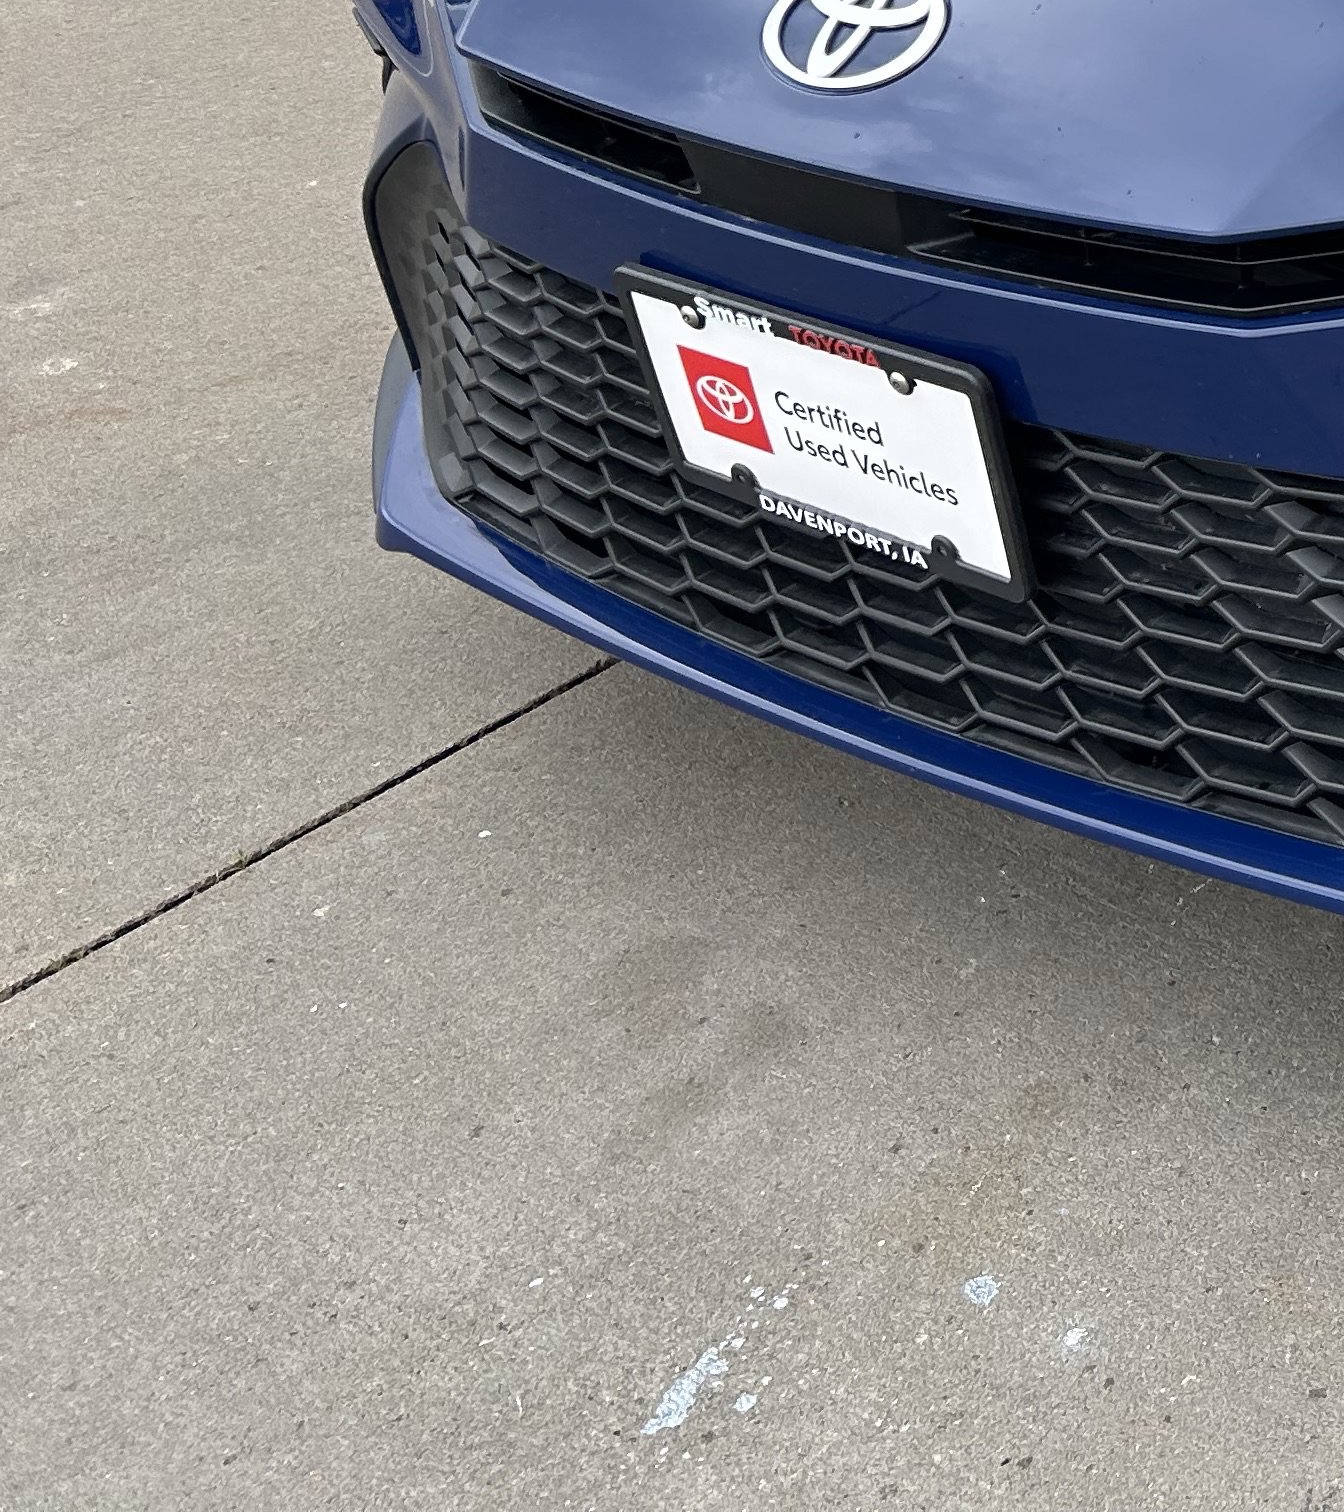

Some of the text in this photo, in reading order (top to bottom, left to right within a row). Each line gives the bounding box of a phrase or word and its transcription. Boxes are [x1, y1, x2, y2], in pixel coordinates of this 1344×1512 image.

[693, 297, 880, 369] Smart TOYOTA
[775, 390, 884, 447] Certified
[784, 426, 960, 506] Used Vehicles
[758, 494, 928, 569] DAVENPORT, IA
